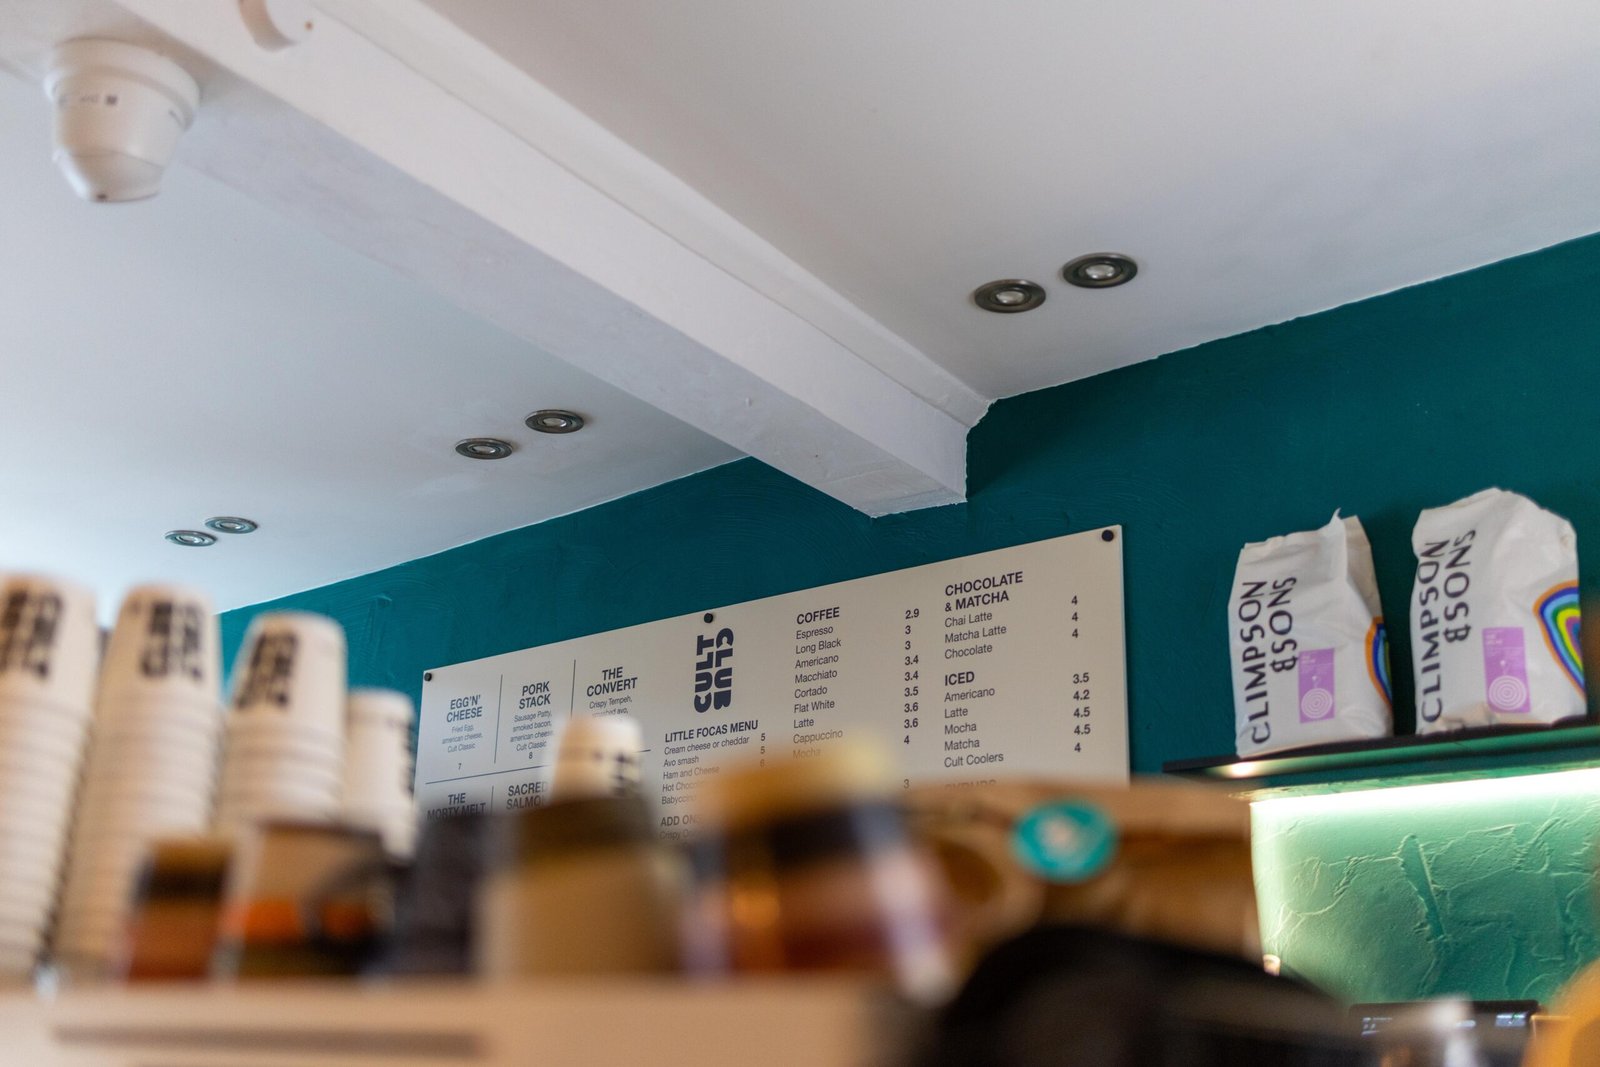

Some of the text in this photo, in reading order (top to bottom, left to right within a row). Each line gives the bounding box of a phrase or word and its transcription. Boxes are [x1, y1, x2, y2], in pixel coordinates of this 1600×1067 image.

[945, 571, 1023, 596] CHOCOLATE
[944, 590, 1009, 612] & MATCHA
[1071, 595, 1078, 605] 4
[796, 607, 840, 624] COFFEE
[905, 608, 920, 619] 2.9
[944, 611, 993, 628] Chai Latte
[1071, 612, 1078, 622] 4
[796, 626, 834, 640] Espresso
[904, 625, 911, 635] 3
[944, 625, 1007, 643] Matcha Latte
[1071, 628, 1079, 639] 4
[1417, 540, 1450, 723] CLIMPSON
[795, 638, 842, 655] Long Black
[904, 640, 911, 650] 3
[944, 644, 993, 659] Chocolate
[795, 654, 839, 669] Americano
[904, 655, 919, 666] 3.4
[1239, 581, 1271, 744] CLIMPSON
[602, 666, 623, 681] THE
[694, 635, 714, 713] CULT
[713, 627, 734, 710] CLUB
[795, 669, 838, 684] Macchiato
[904, 671, 919, 681] 3.4
[944, 671, 975, 686] ICED
[1072, 672, 1090, 684] 3.5
[521, 681, 550, 696] PORK
[586, 677, 638, 697] CONVERT
[794, 685, 828, 699] Cortado
[904, 686, 919, 697] 3.5
[944, 687, 996, 702] Americano
[1073, 689, 1090, 701] 4.2
[450, 694, 481, 710] EGG'N'
[519, 694, 551, 710] STACK
[589, 700, 607, 709] Crispy
[794, 700, 835, 713] Flat White
[904, 702, 919, 713] 3.6
[446, 706, 483, 722] CHEESE
[514, 713, 536, 722] Sausage
[944, 707, 969, 719] Latte
[1073, 706, 1091, 718] 4.5
[512, 723, 533, 732] smoked
[793, 718, 815, 729] Latte
[904, 718, 919, 728] 3.6
[944, 722, 977, 735] Mocha
[1073, 723, 1091, 735] 4.5
[664, 719, 759, 743] LITTLE FOCAS MENU
[760, 733, 766, 741] 5
[793, 729, 843, 744] Cappuccino
[664, 736, 750, 755] Cream cheese or cheddar
[903, 735, 910, 744] 4
[944, 738, 980, 751] Matcha
[760, 746, 766, 754] 5
[1074, 742, 1081, 752] 4
[663, 755, 699, 767] Avo smash
[944, 752, 1004, 768] Cult Coolers
[662, 771, 679, 780] Ham
[679, 768, 693, 778] and
[662, 784, 675, 792] Hot
[903, 779, 910, 789] 3
[448, 792, 466, 805] THE
[660, 815, 680, 827] ADD
